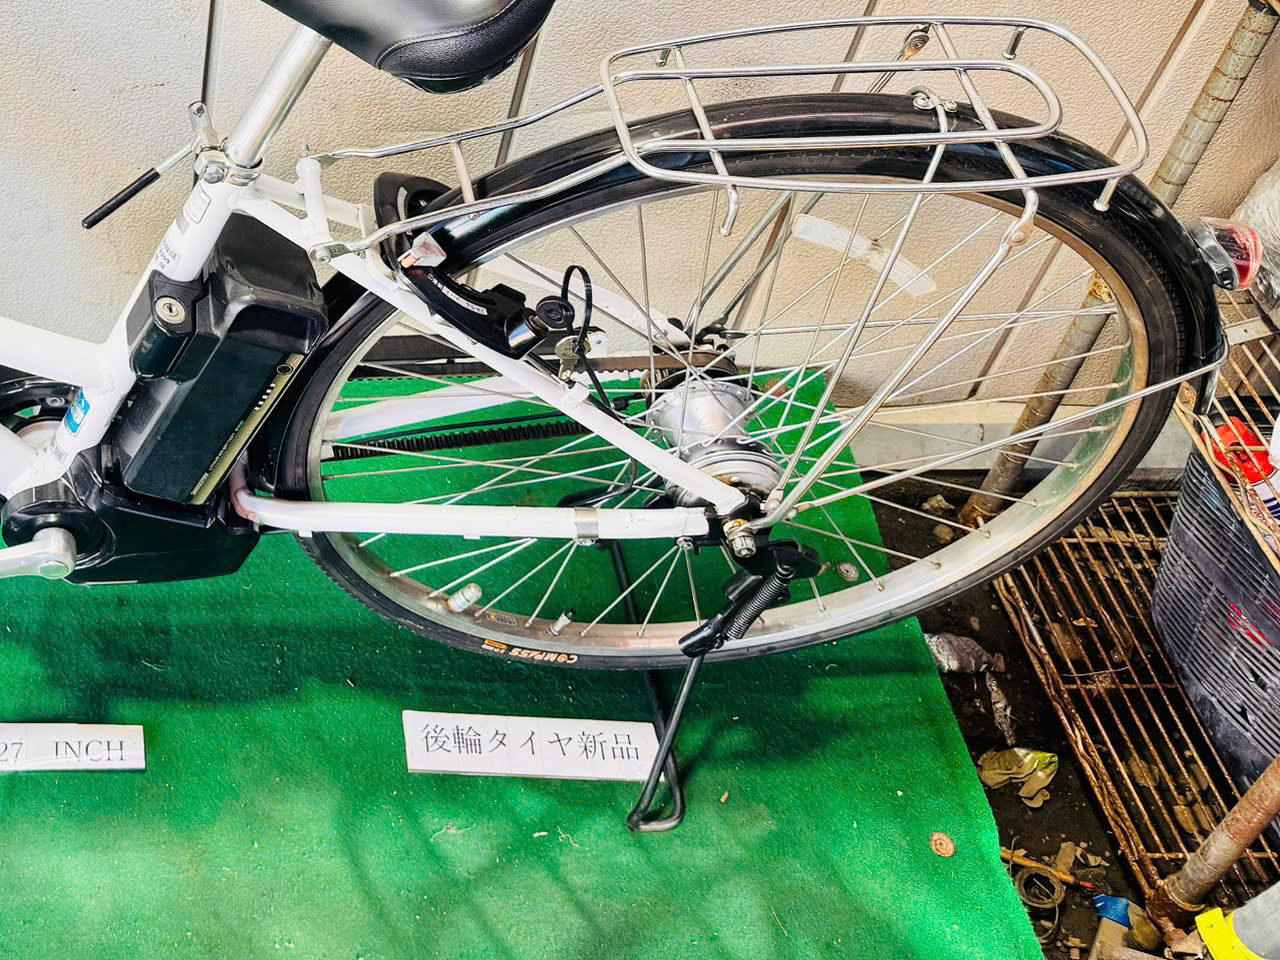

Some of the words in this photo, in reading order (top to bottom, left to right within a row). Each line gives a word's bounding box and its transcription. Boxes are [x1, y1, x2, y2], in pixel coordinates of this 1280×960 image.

[509, 647, 579, 664] COMPASS
[53, 739, 125, 762] INCH
[421, 723, 640, 760] 後輪タイヤ新品
